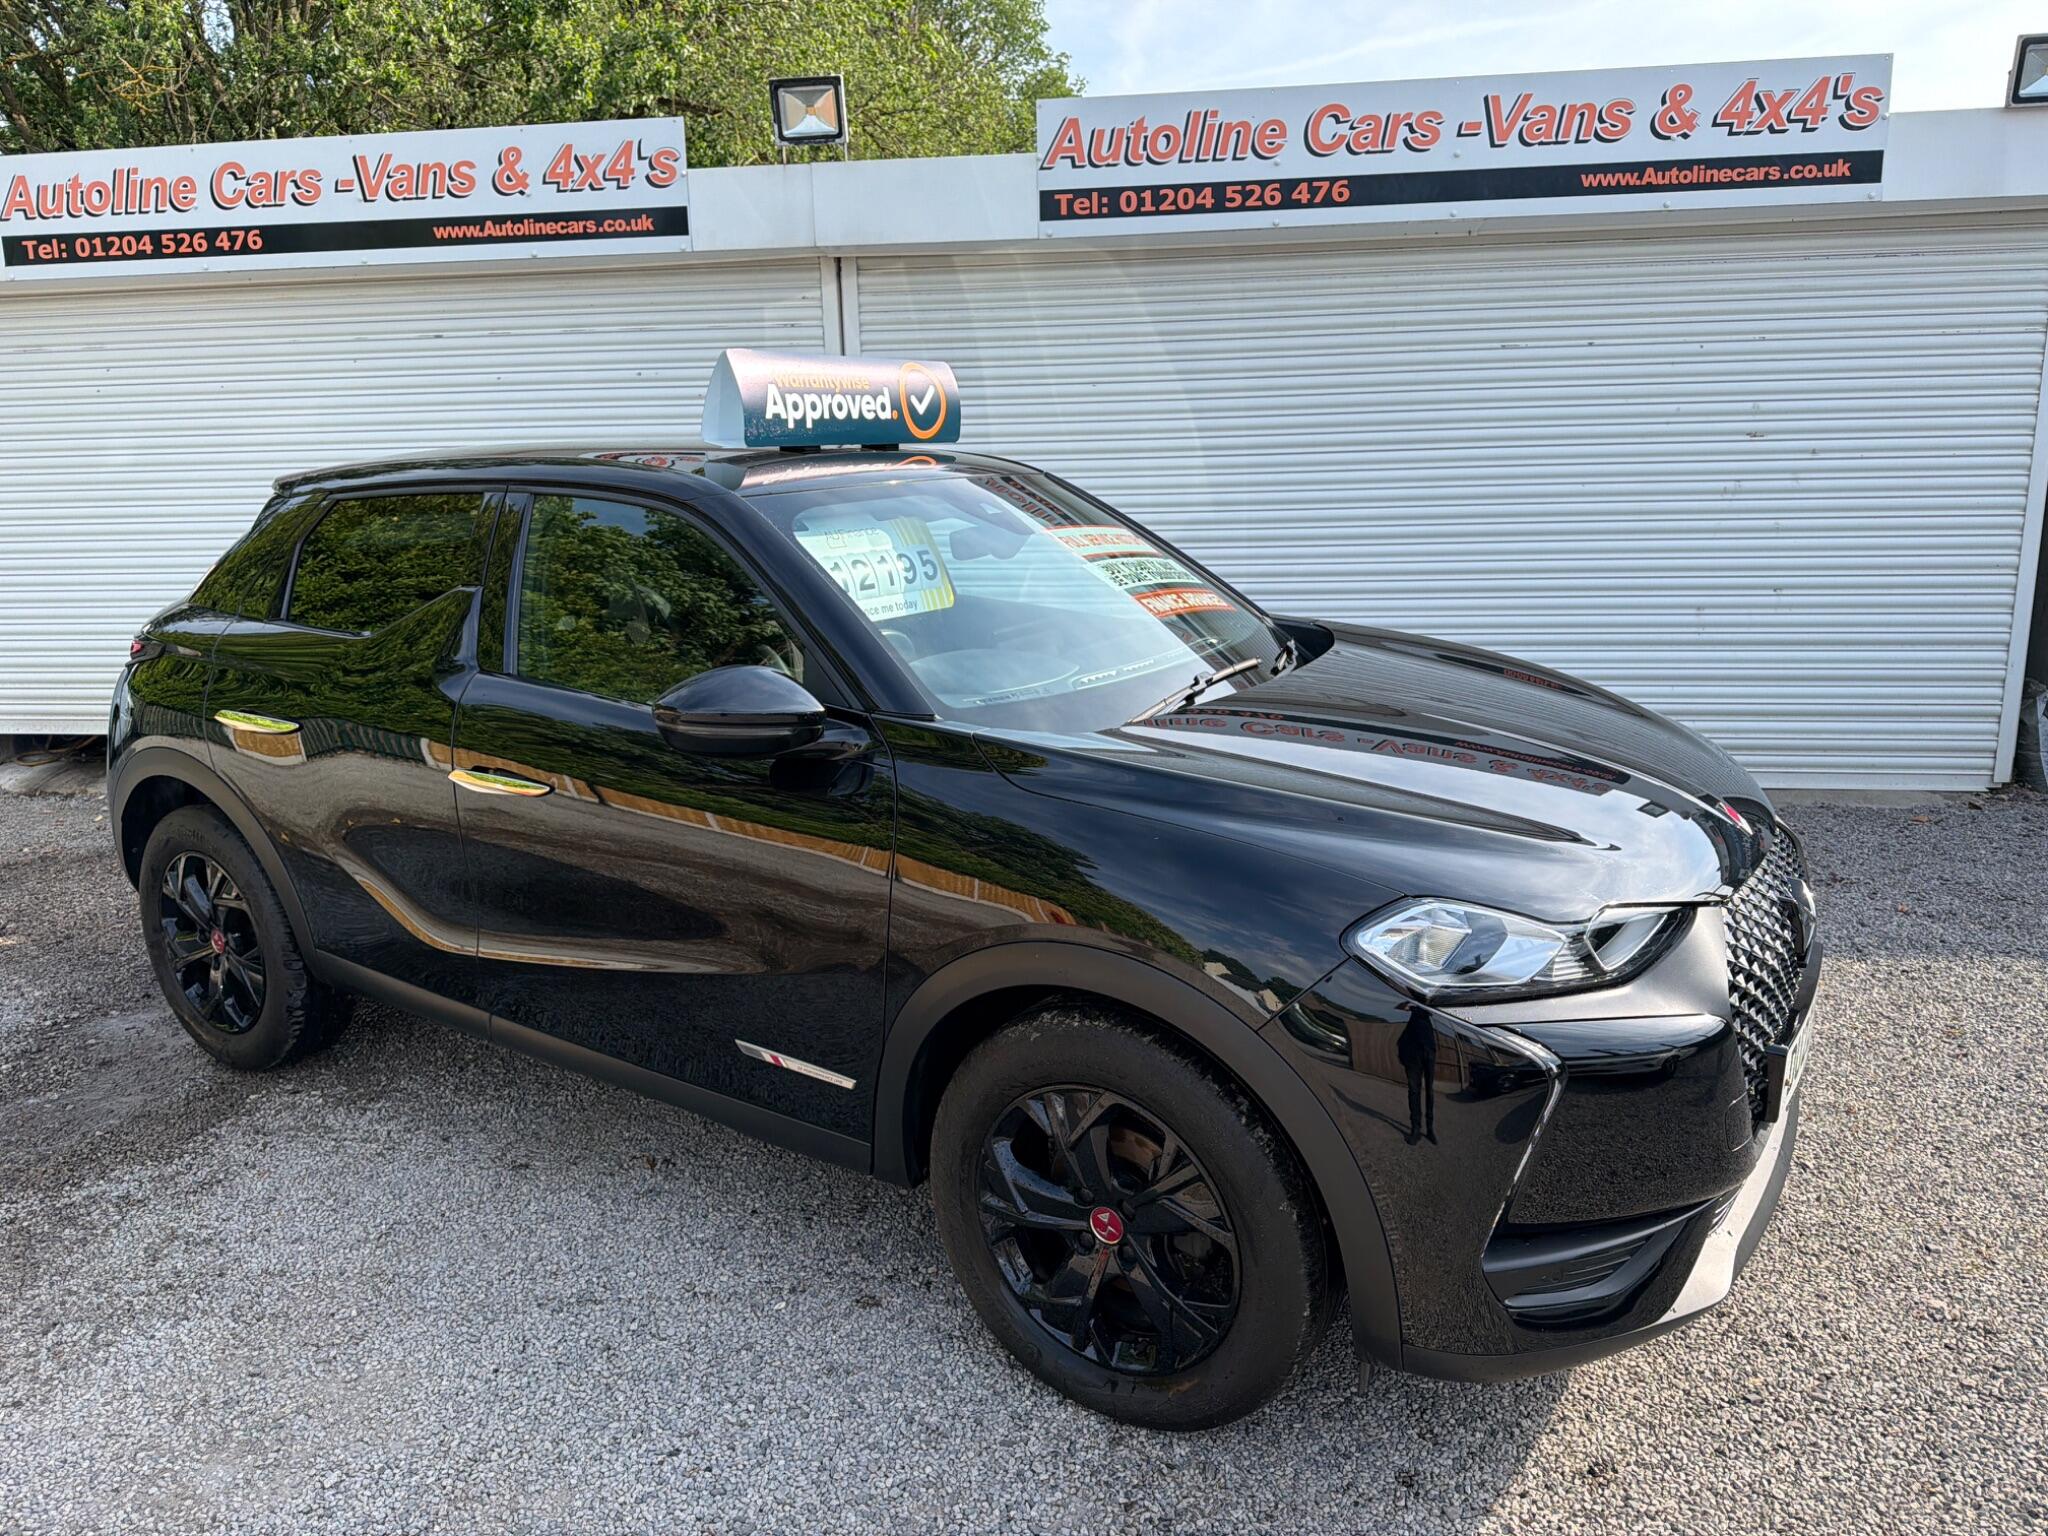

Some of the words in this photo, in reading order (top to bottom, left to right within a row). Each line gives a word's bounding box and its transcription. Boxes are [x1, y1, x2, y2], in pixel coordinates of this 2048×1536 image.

[1039, 108, 1288, 171] Autoline
[1304, 102, 1445, 159] Cars
[1650, 83, 1700, 141] &
[1711, 72, 1885, 137] 4x4's
[2, 165, 197, 220] Autoline
[210, 160, 323, 209] Cars
[492, 146, 530, 196] &
[541, 138, 682, 193] 4x4's
[1580, 158, 1852, 189] www.Autolinecars.co.uk
[1054, 192, 1109, 216] Tel:
[1118, 186, 1216, 214] 01204
[1224, 182, 1283, 208] 526
[1290, 179, 1351, 205] 476
[432, 213, 656, 241] www.Autolinecars.co.uk
[22, 237, 68, 261] Tel:
[75, 233, 153, 259] 01204
[161, 231, 209, 255] 526
[214, 229, 264, 253] 476
[765, 384, 899, 430] Approved.
[881, 602, 894, 614] me
[895, 600, 918, 614] today
